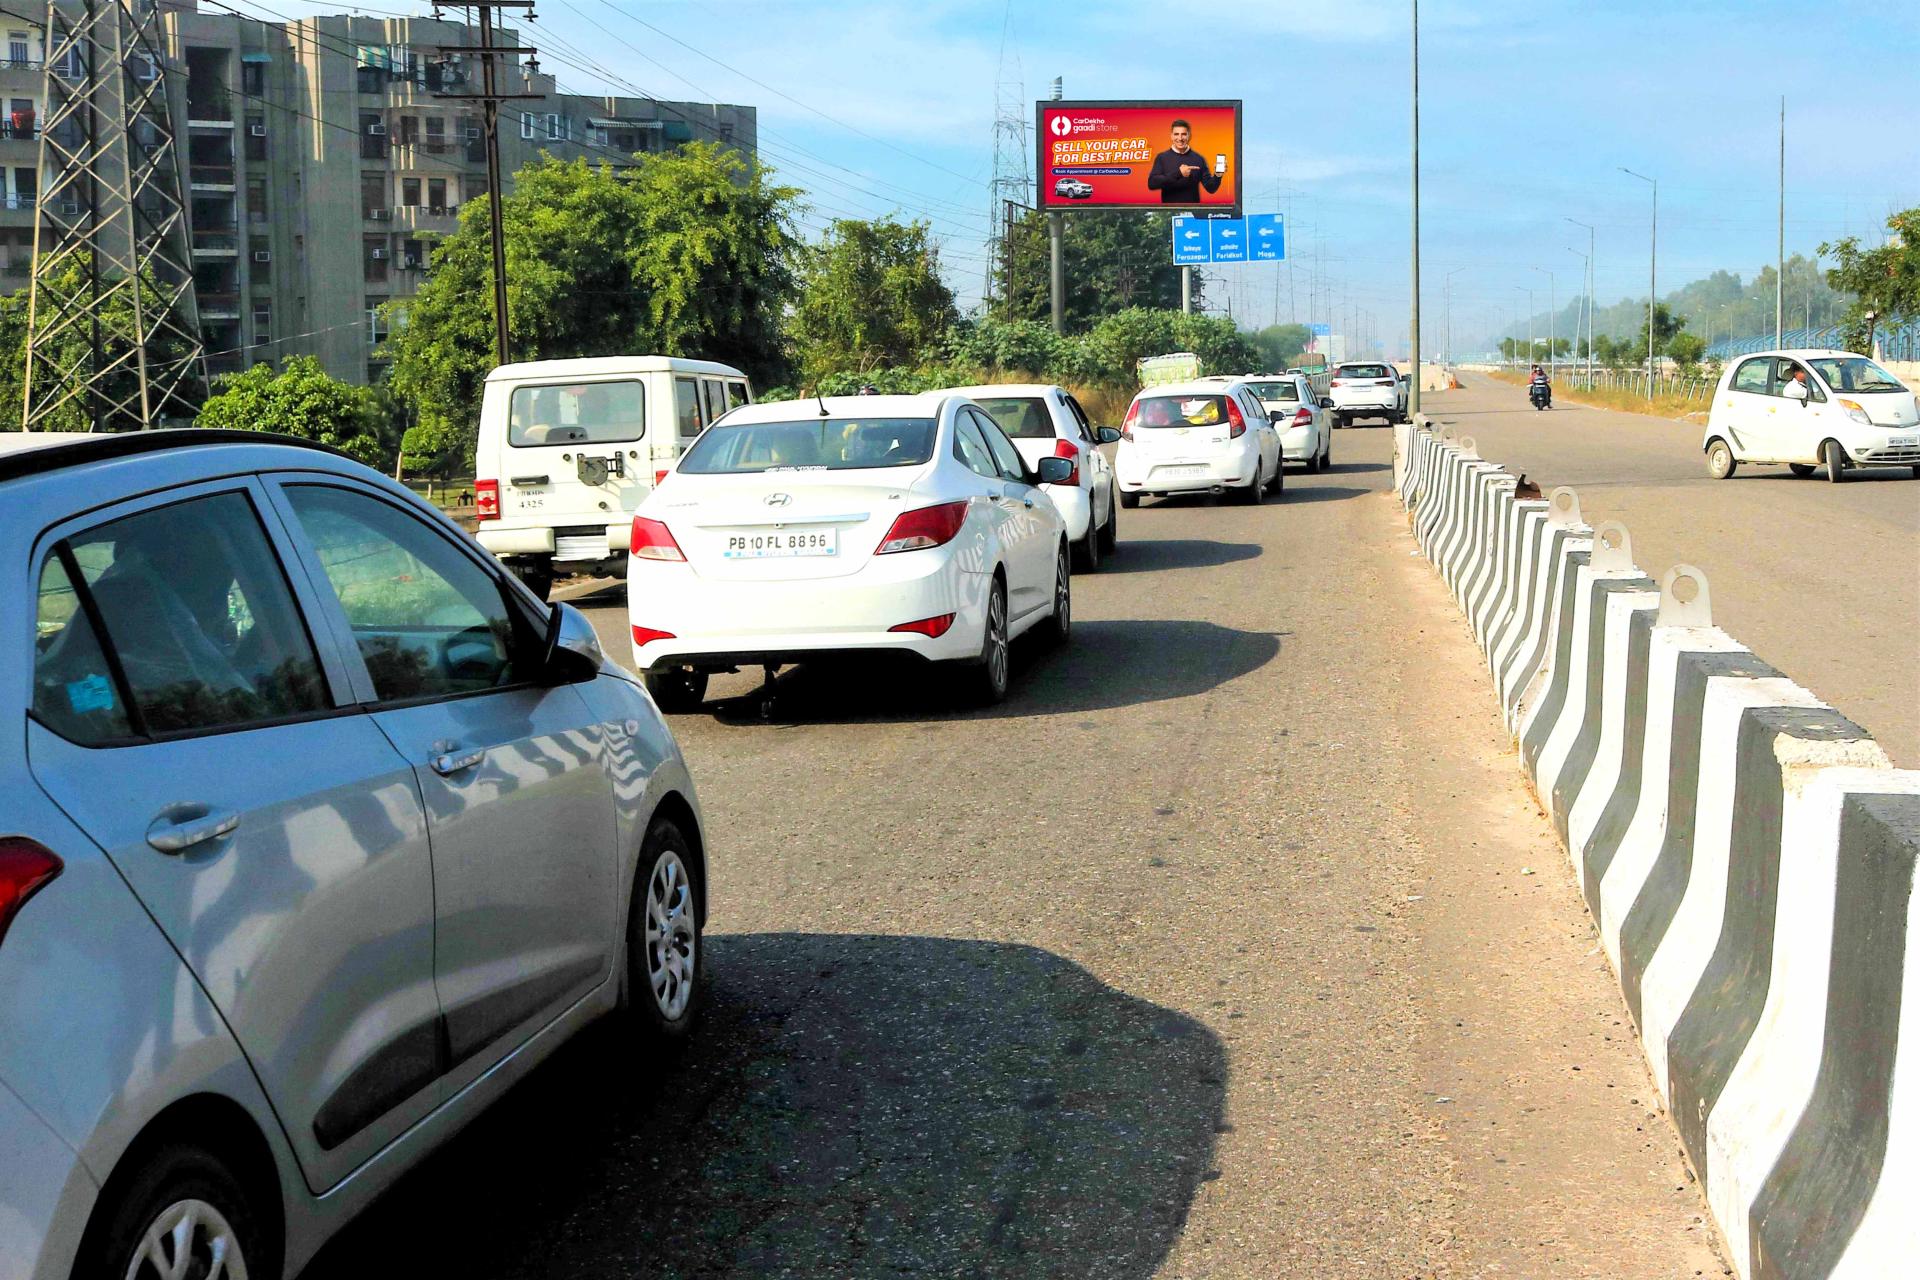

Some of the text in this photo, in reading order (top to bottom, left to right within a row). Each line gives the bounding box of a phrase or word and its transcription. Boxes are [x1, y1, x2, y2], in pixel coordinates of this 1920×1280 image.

[1073, 124, 1095, 133] gaadi
[1055, 140, 1145, 153] SELL YOUR CAR
[1055, 151, 1149, 163] FOR BEST PRICE
[729, 534, 826, 550] PB 10 FL 8896
